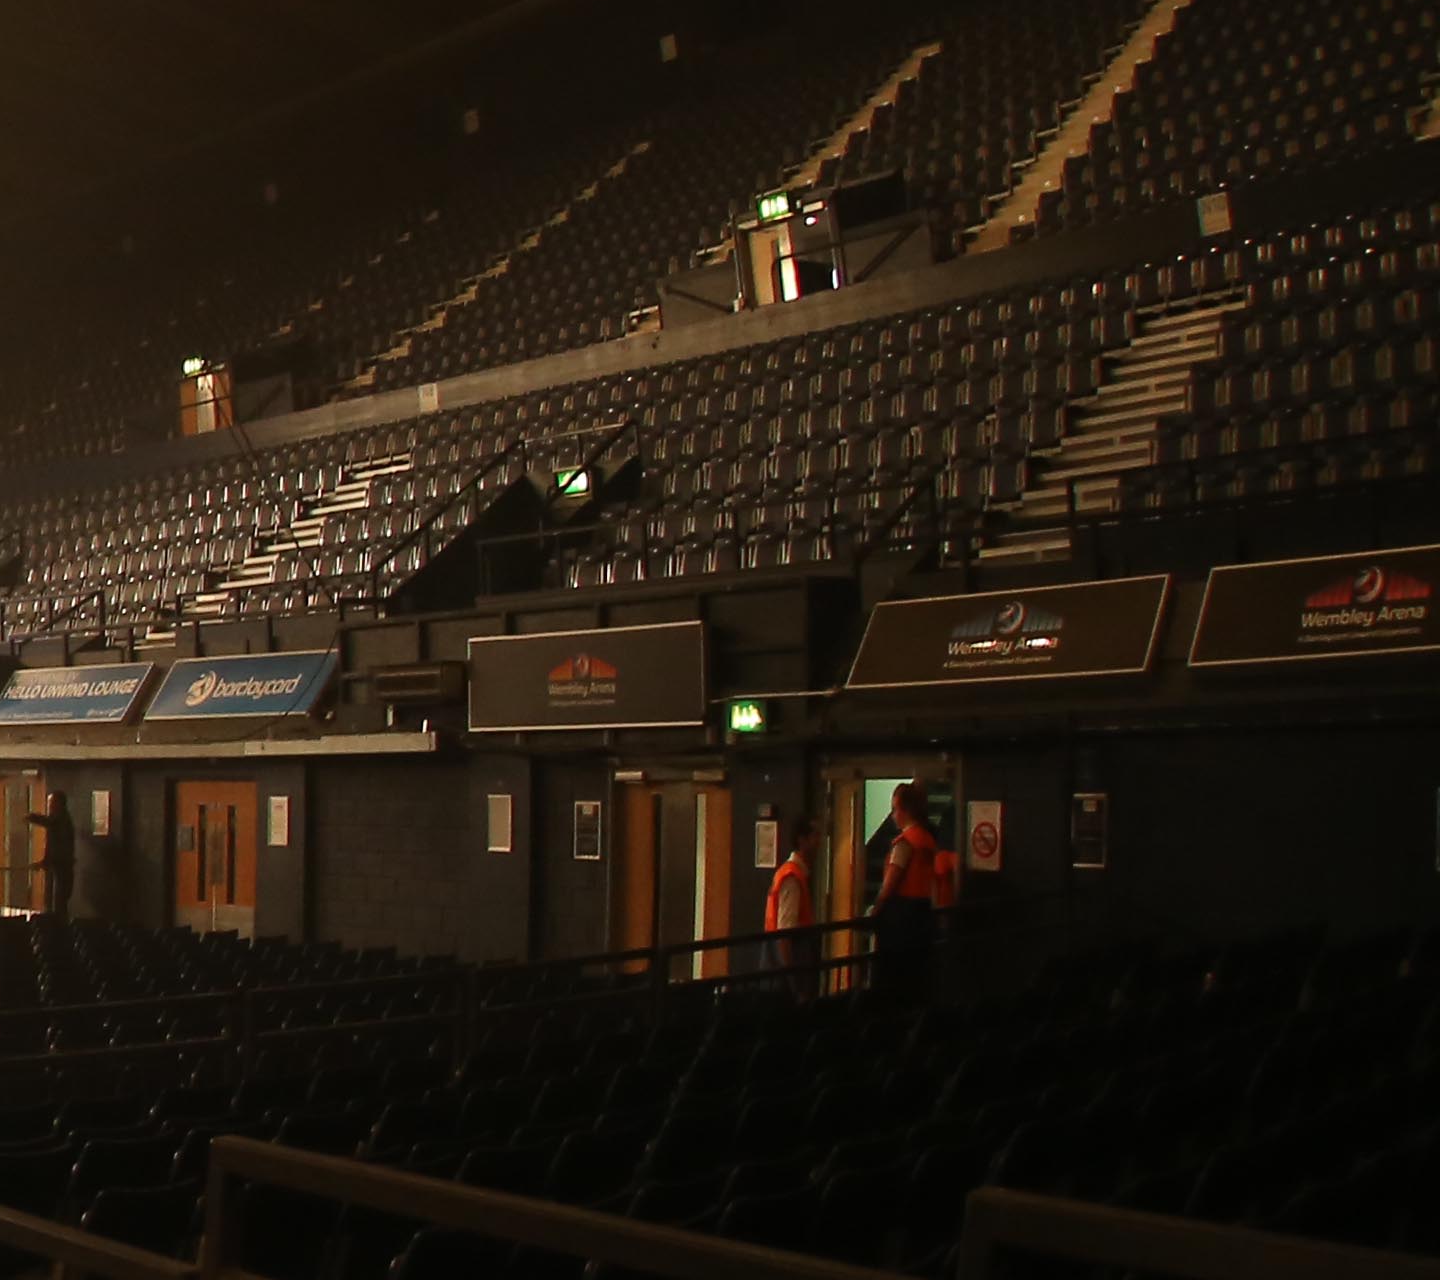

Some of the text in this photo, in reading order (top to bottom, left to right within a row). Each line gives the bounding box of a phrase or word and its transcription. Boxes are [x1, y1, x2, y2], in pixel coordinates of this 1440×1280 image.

[1300, 606, 1425, 629] Wembley Arena
[3, 684, 41, 700] HELLO
[87, 677, 140, 697] LOUNGE
[213, 673, 302, 699] barclaycard
